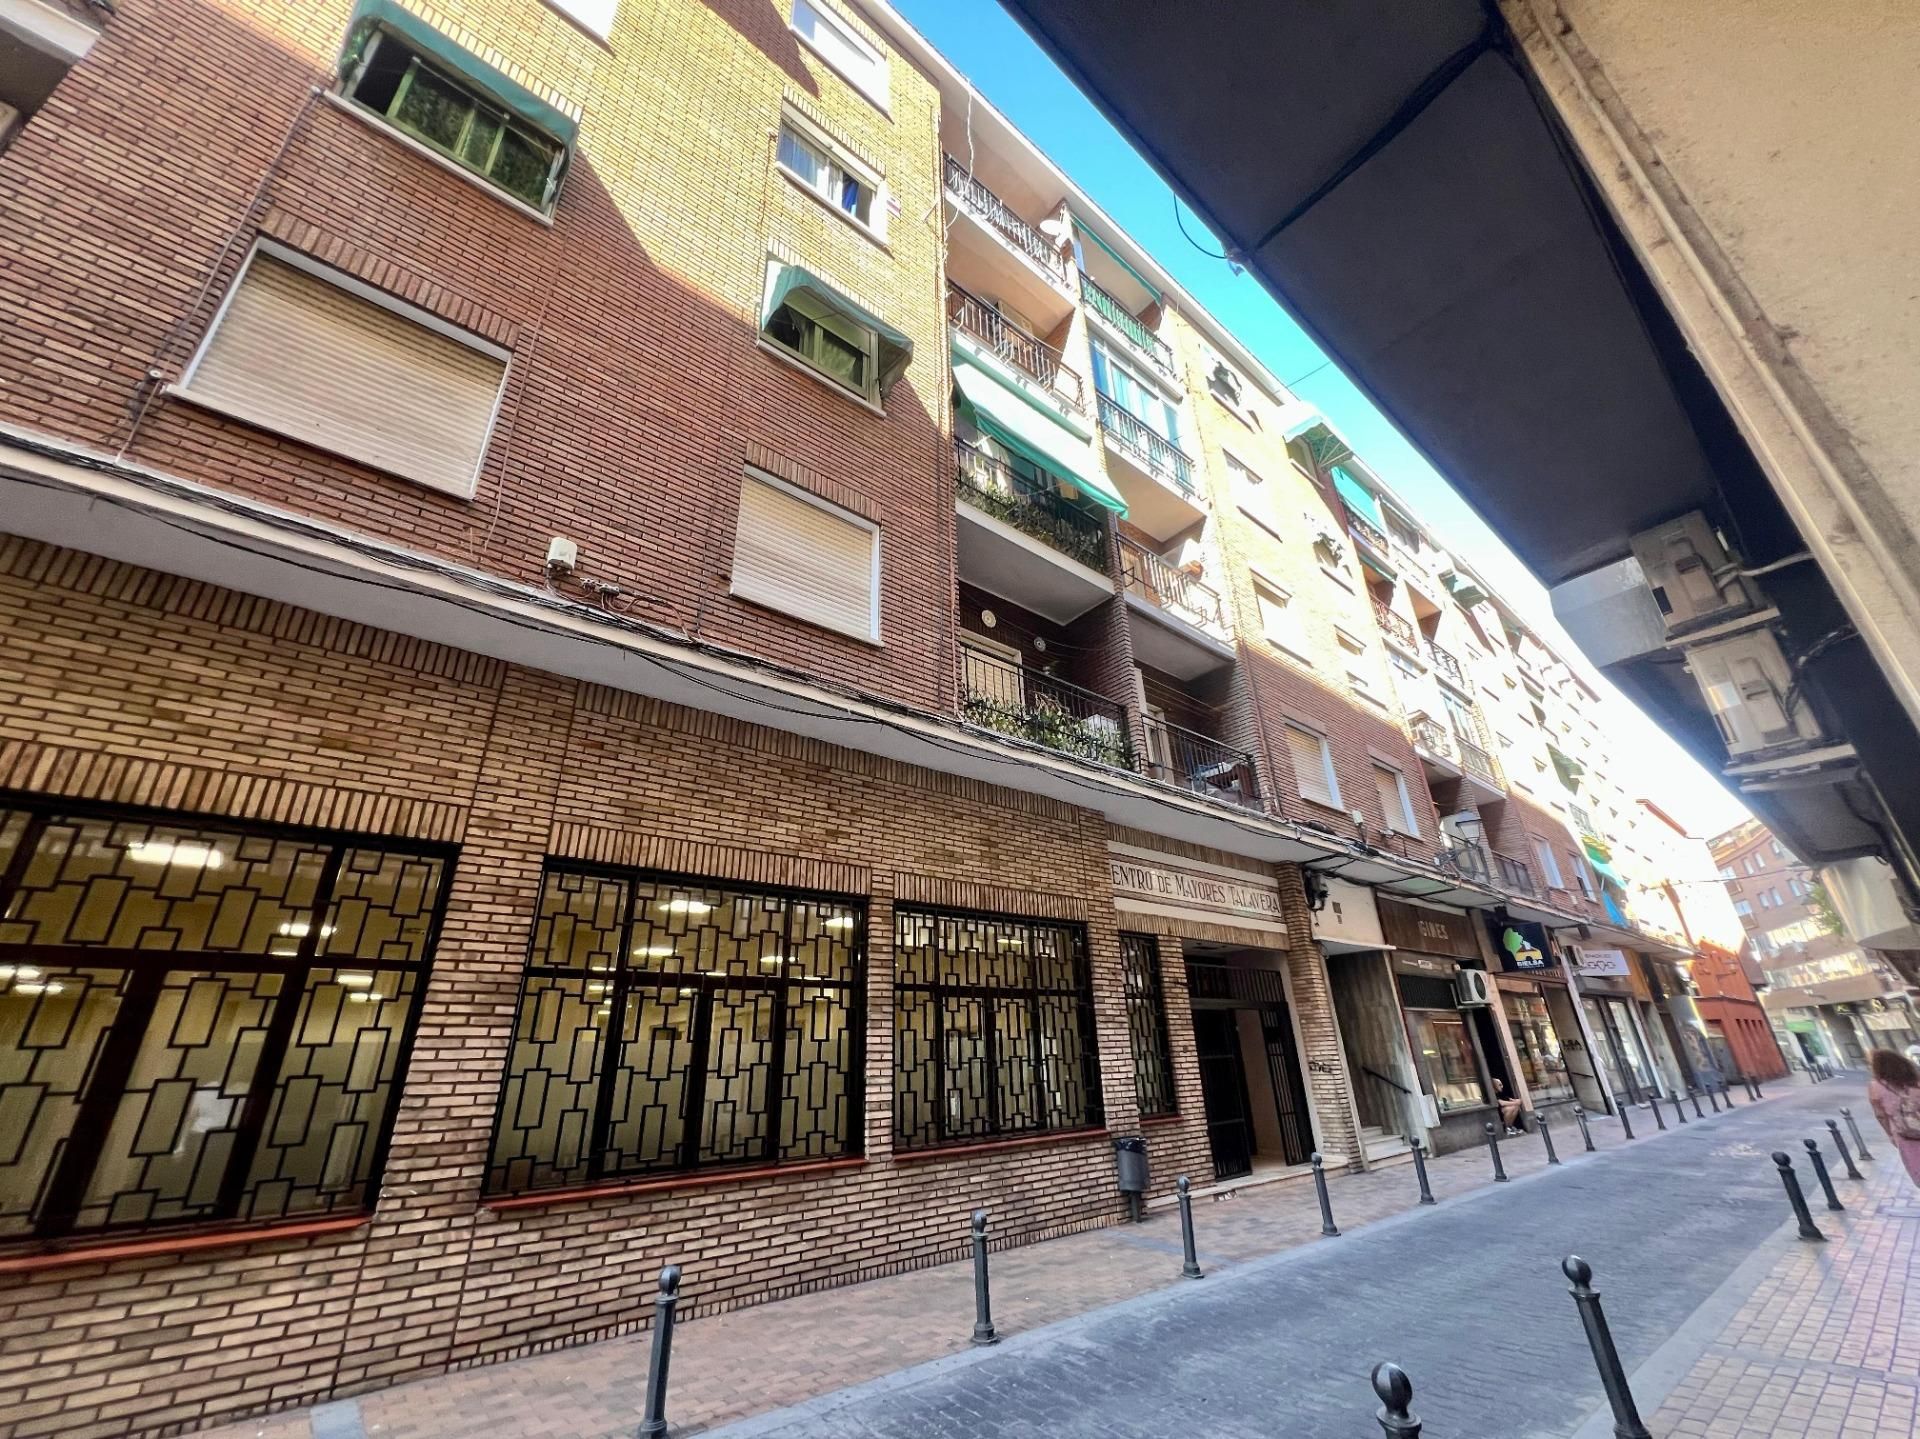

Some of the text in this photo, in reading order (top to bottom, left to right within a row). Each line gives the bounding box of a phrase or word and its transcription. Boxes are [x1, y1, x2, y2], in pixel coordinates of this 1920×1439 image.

[1111, 864, 1280, 914] ENTRO DE MAYORES TALAVERA
